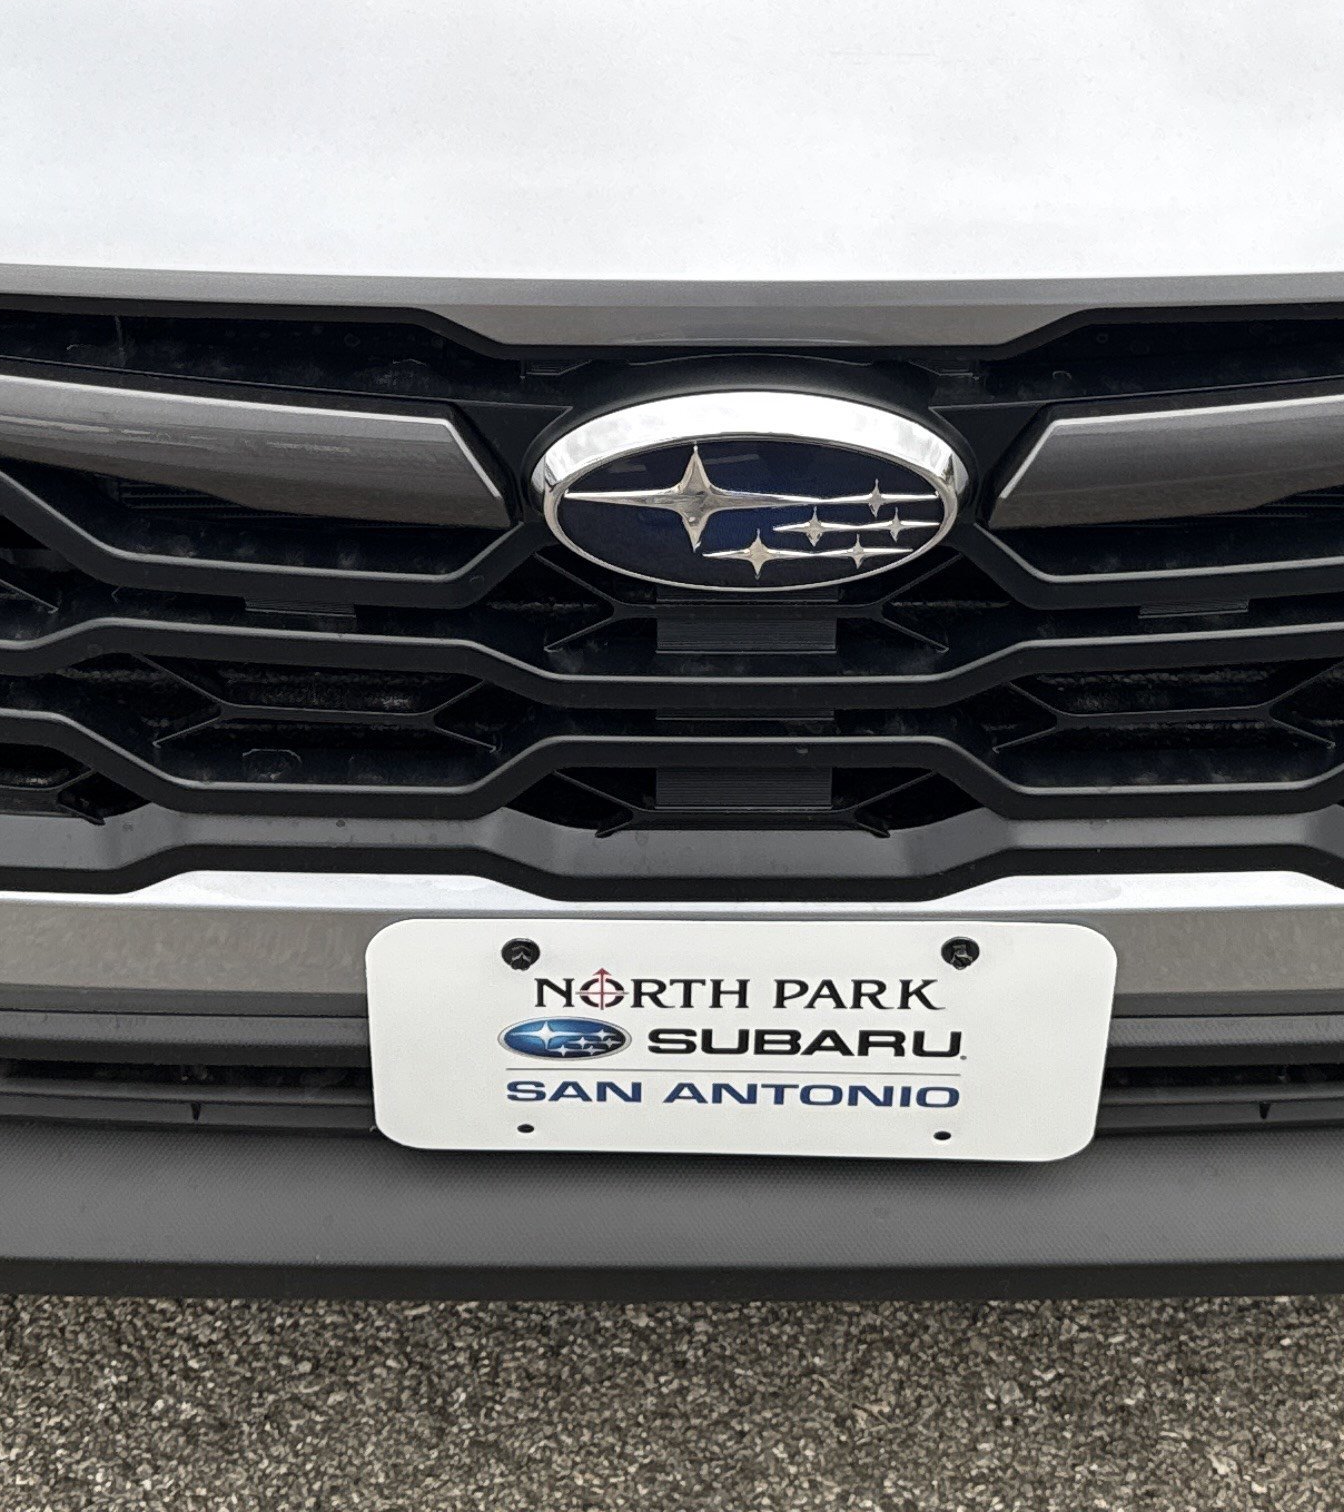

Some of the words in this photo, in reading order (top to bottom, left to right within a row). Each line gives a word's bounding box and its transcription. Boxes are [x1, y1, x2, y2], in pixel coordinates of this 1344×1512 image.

[534, 976, 751, 1010] NORTH
[772, 978, 946, 1011] PARK
[647, 1027, 963, 1058] SUBARU
[505, 1079, 643, 1103] SAN
[662, 1081, 960, 1108] ANTONIO
